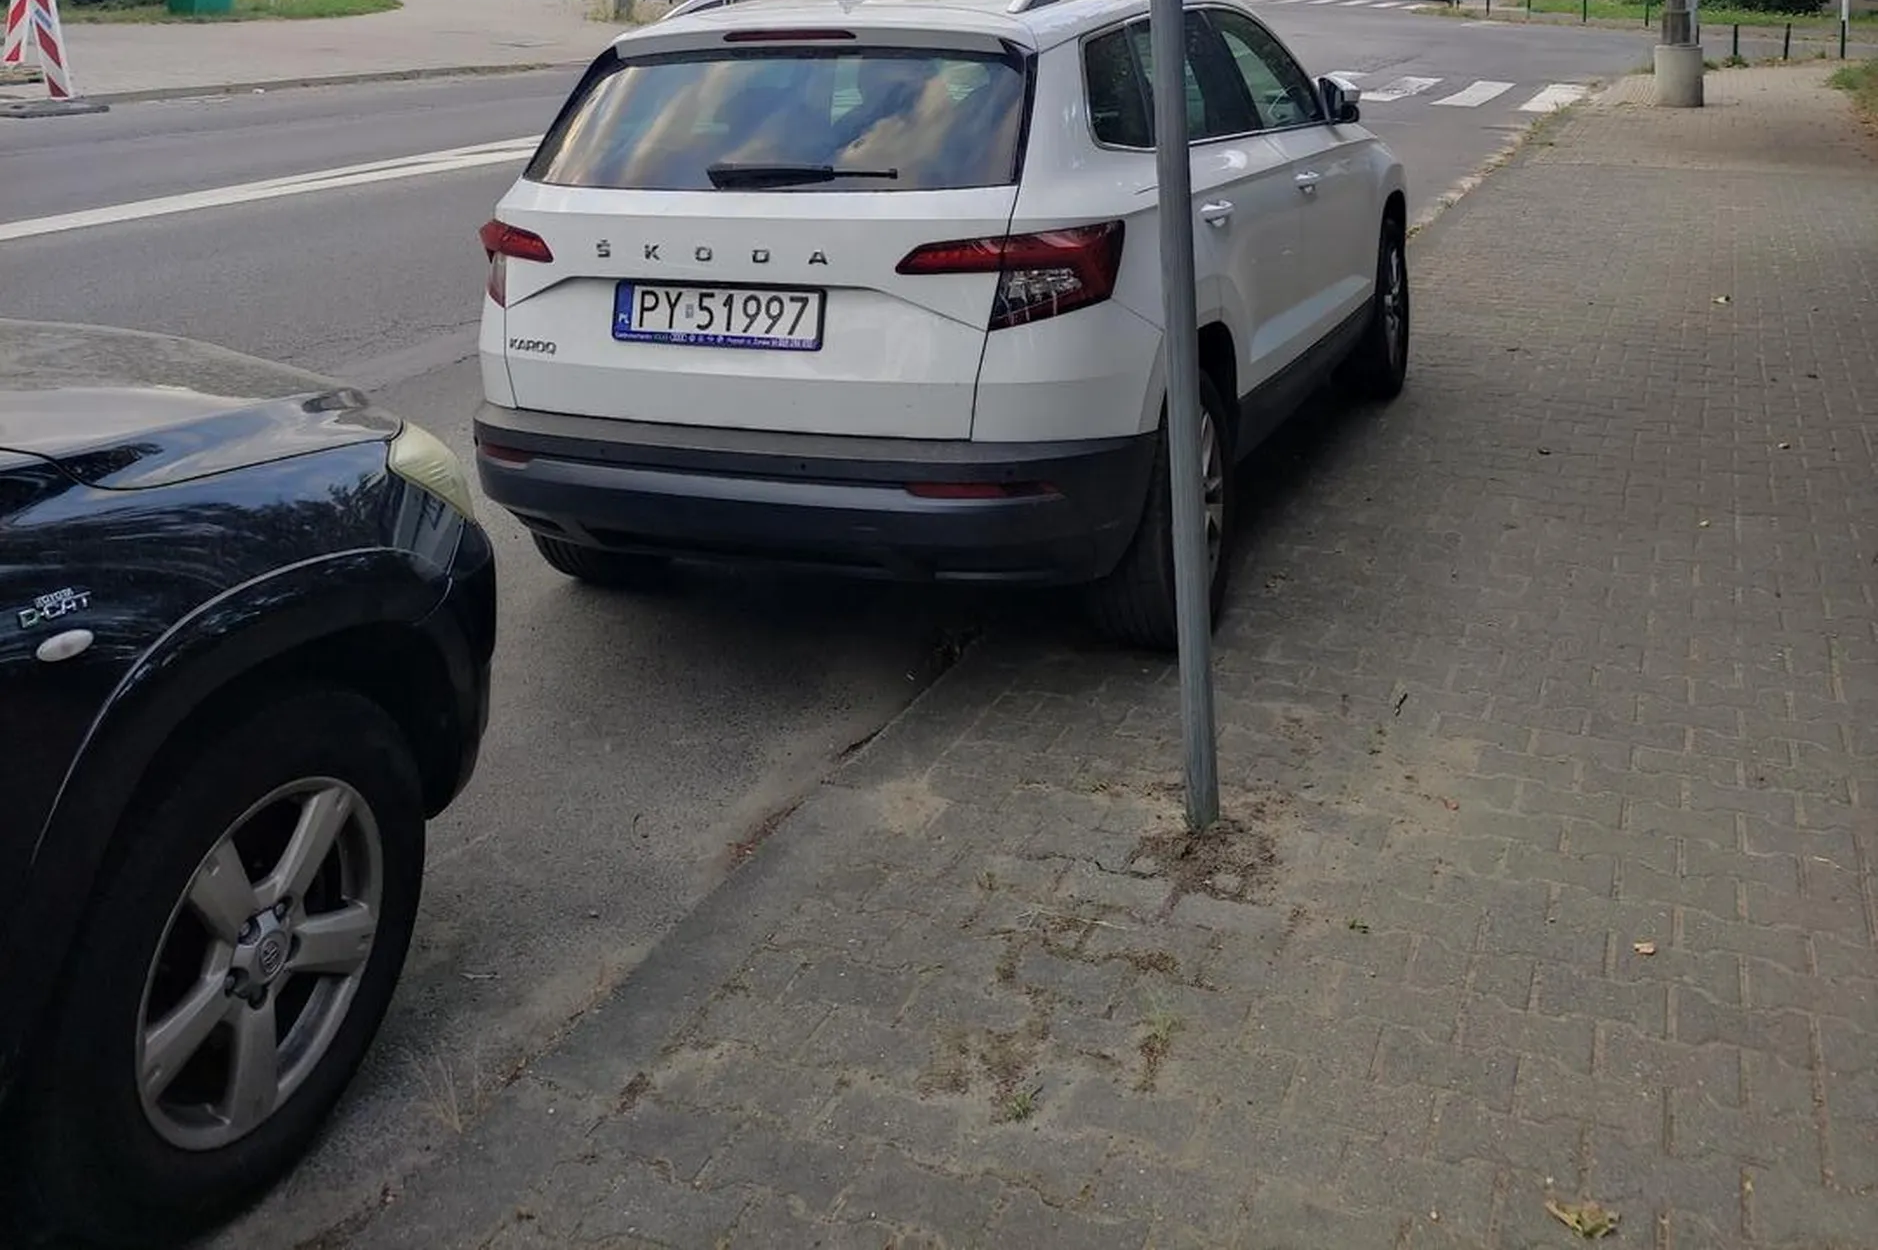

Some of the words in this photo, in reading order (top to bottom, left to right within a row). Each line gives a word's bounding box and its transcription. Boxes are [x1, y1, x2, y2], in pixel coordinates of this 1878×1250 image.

[596, 239, 828, 266] ŠKODA
[638, 290, 684, 329] PY
[696, 292, 810, 337] 51997
[510, 337, 557, 355] KAROQ
